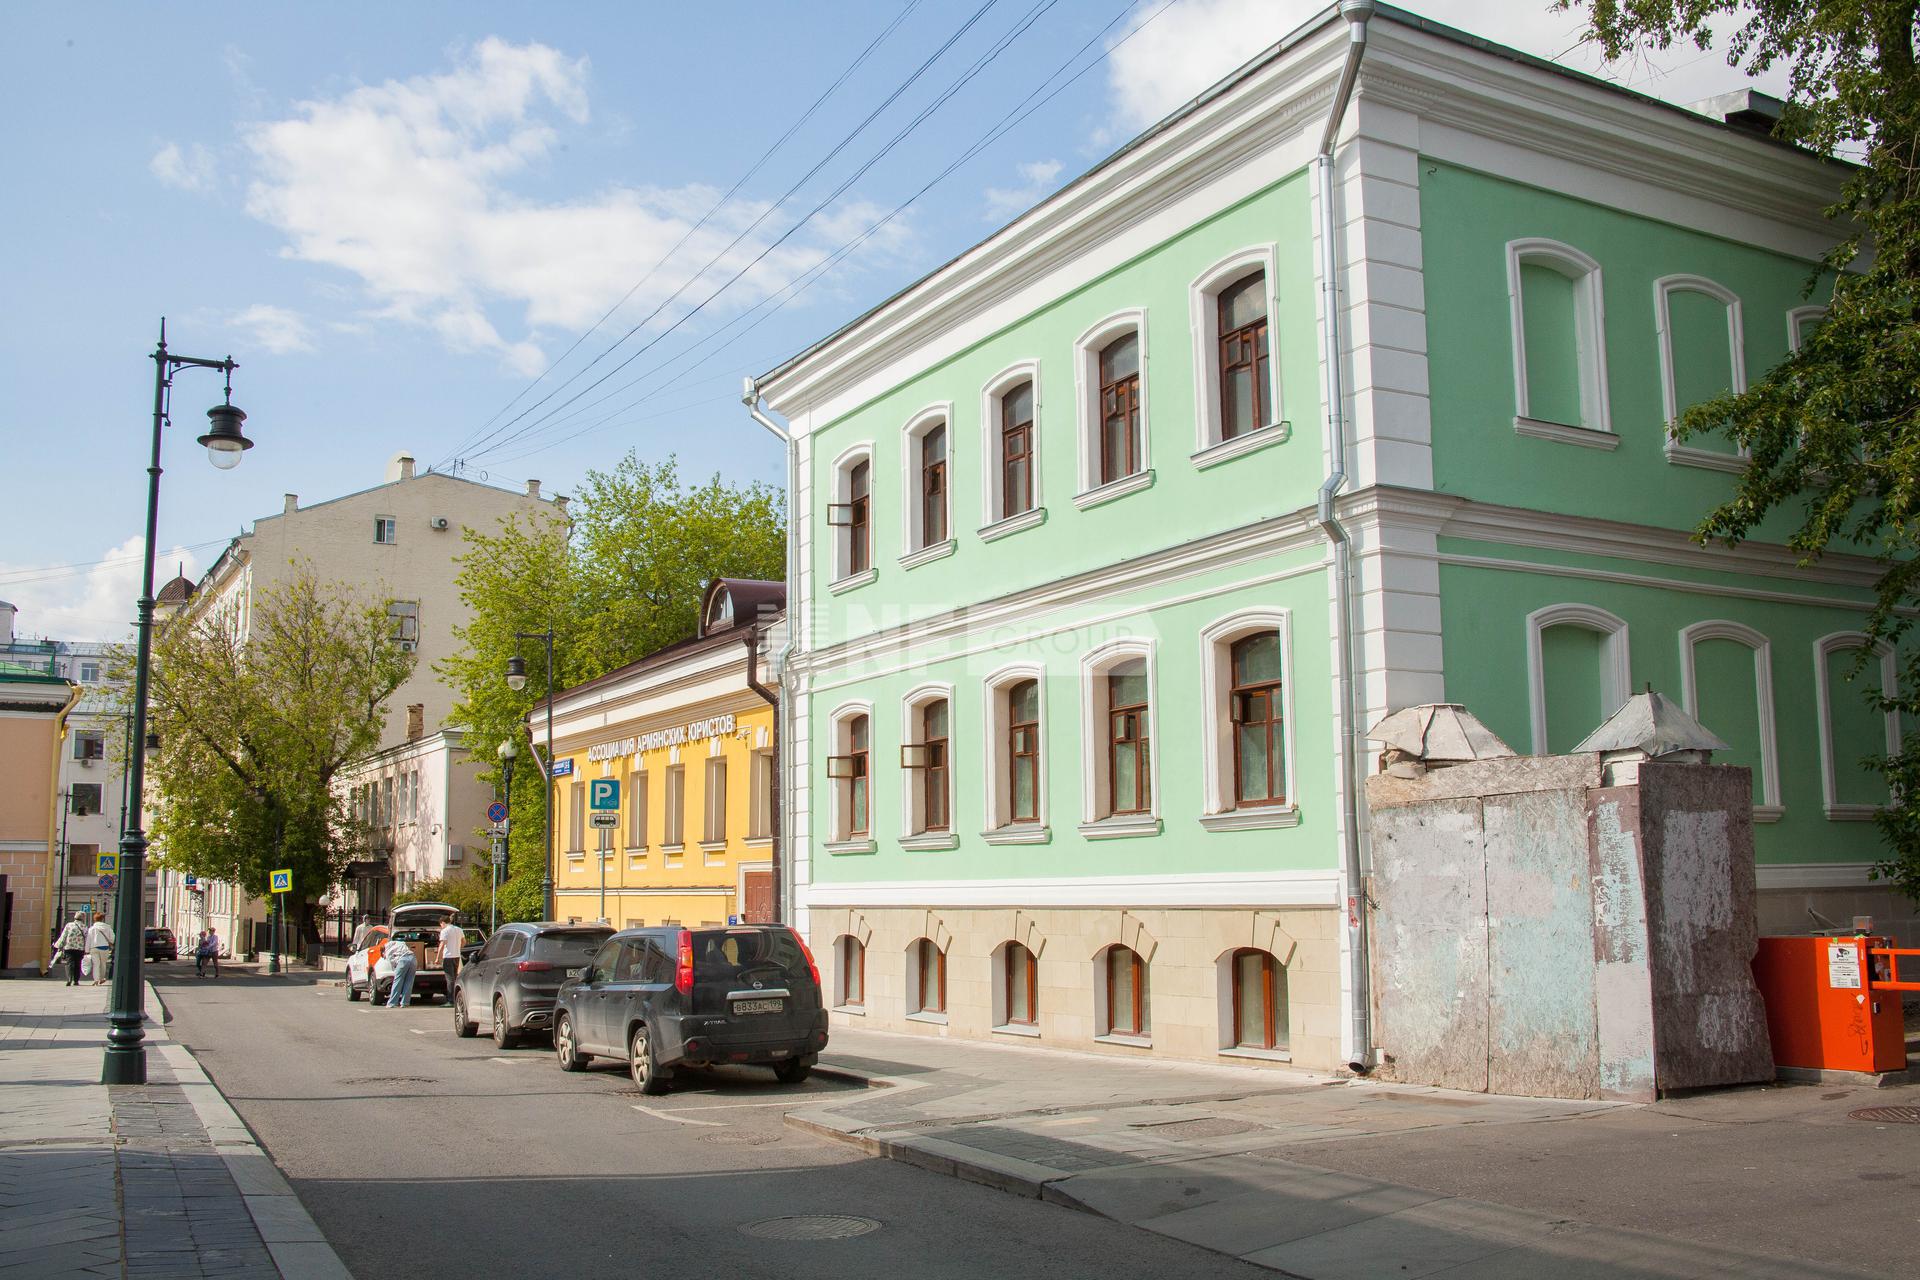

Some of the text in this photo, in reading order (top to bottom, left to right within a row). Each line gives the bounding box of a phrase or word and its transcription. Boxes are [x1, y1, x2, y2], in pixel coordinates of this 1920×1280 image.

[588, 714, 734, 762] АССОЦИАЦИЯ АРМЯНСКИХ ЮРИСТОВ
[594, 783, 613, 806] P
